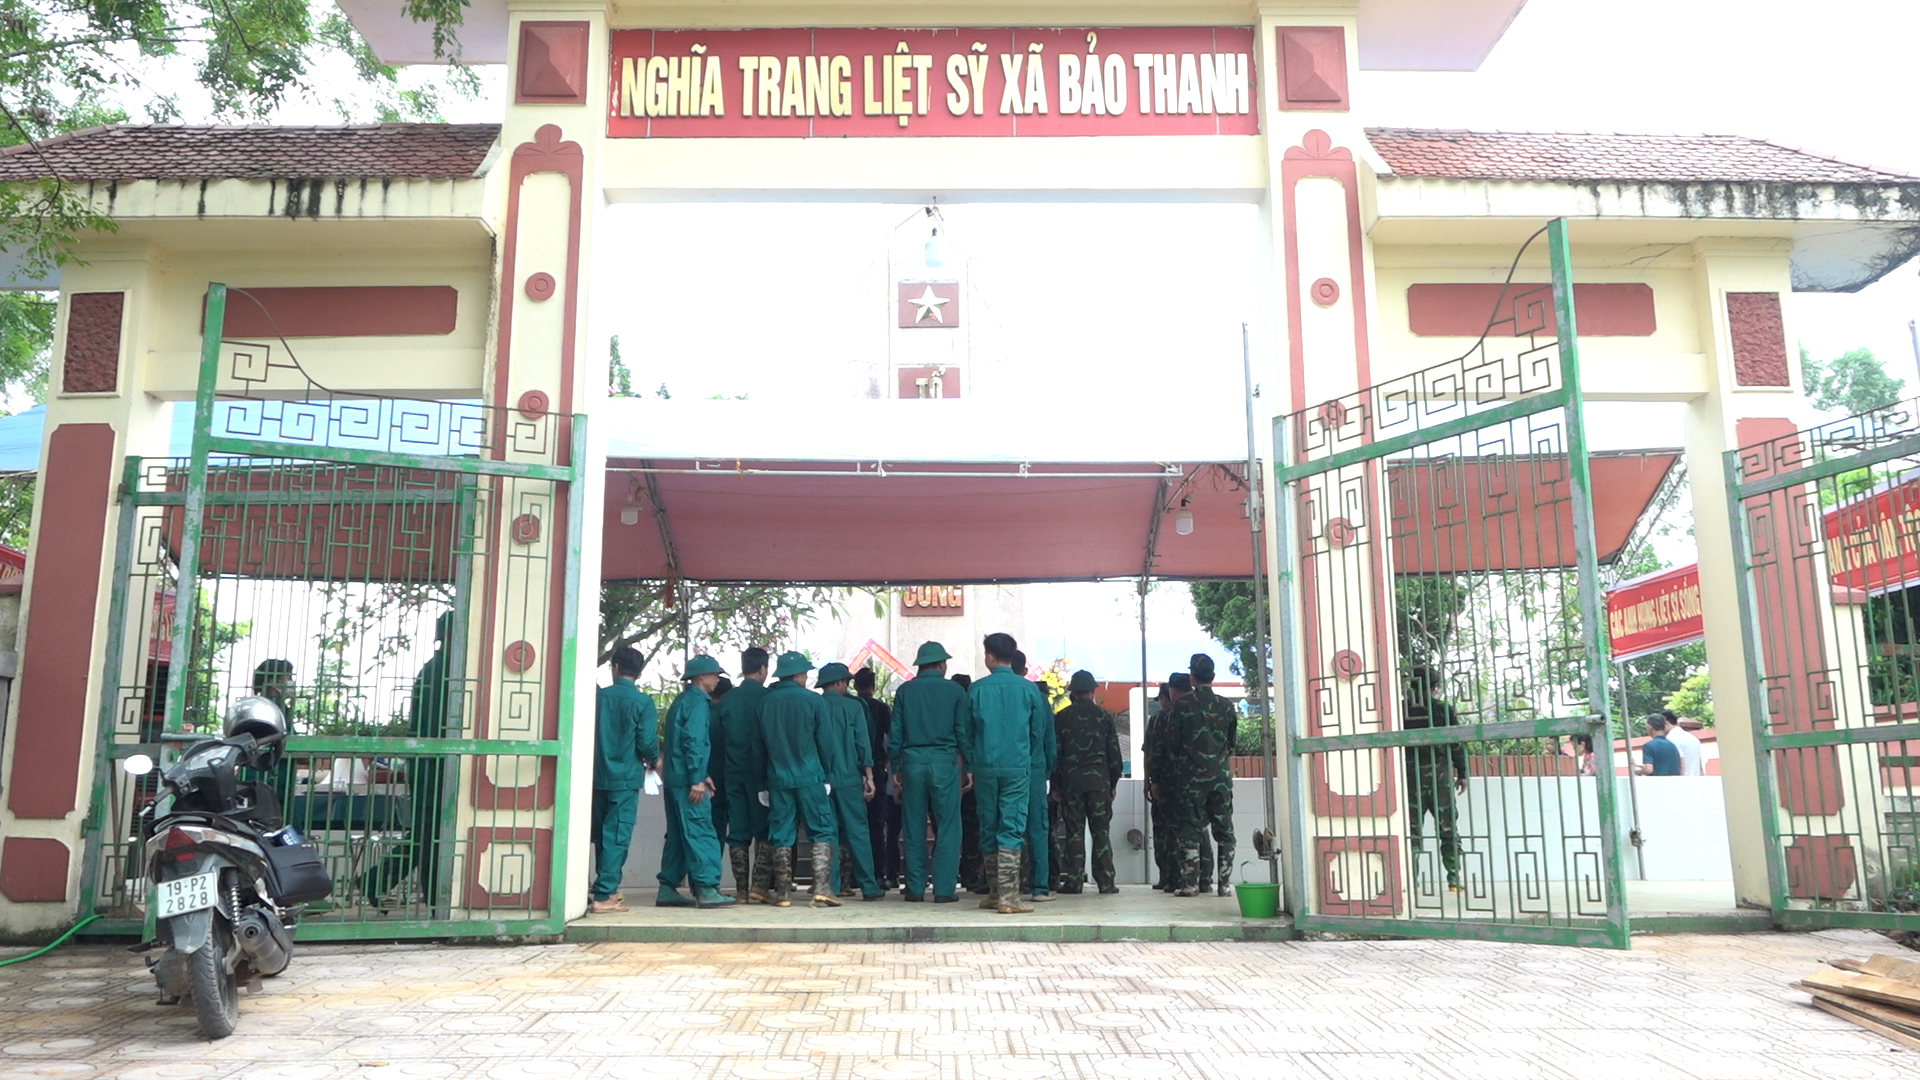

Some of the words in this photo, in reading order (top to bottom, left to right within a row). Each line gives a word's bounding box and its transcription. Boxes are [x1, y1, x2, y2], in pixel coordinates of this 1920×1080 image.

[621, 44, 724, 118] NGHĨA
[739, 55, 851, 118] TRANG
[863, 42, 933, 127] LIỆT
[946, 41, 988, 116] SỸ
[1000, 42, 1048, 116] XÃ
[1059, 32, 1127, 116] BẢO
[1134, 52, 1249, 115] THANH
[166, 875, 207, 897] 19-P2
[166, 891, 208, 914] 2828
